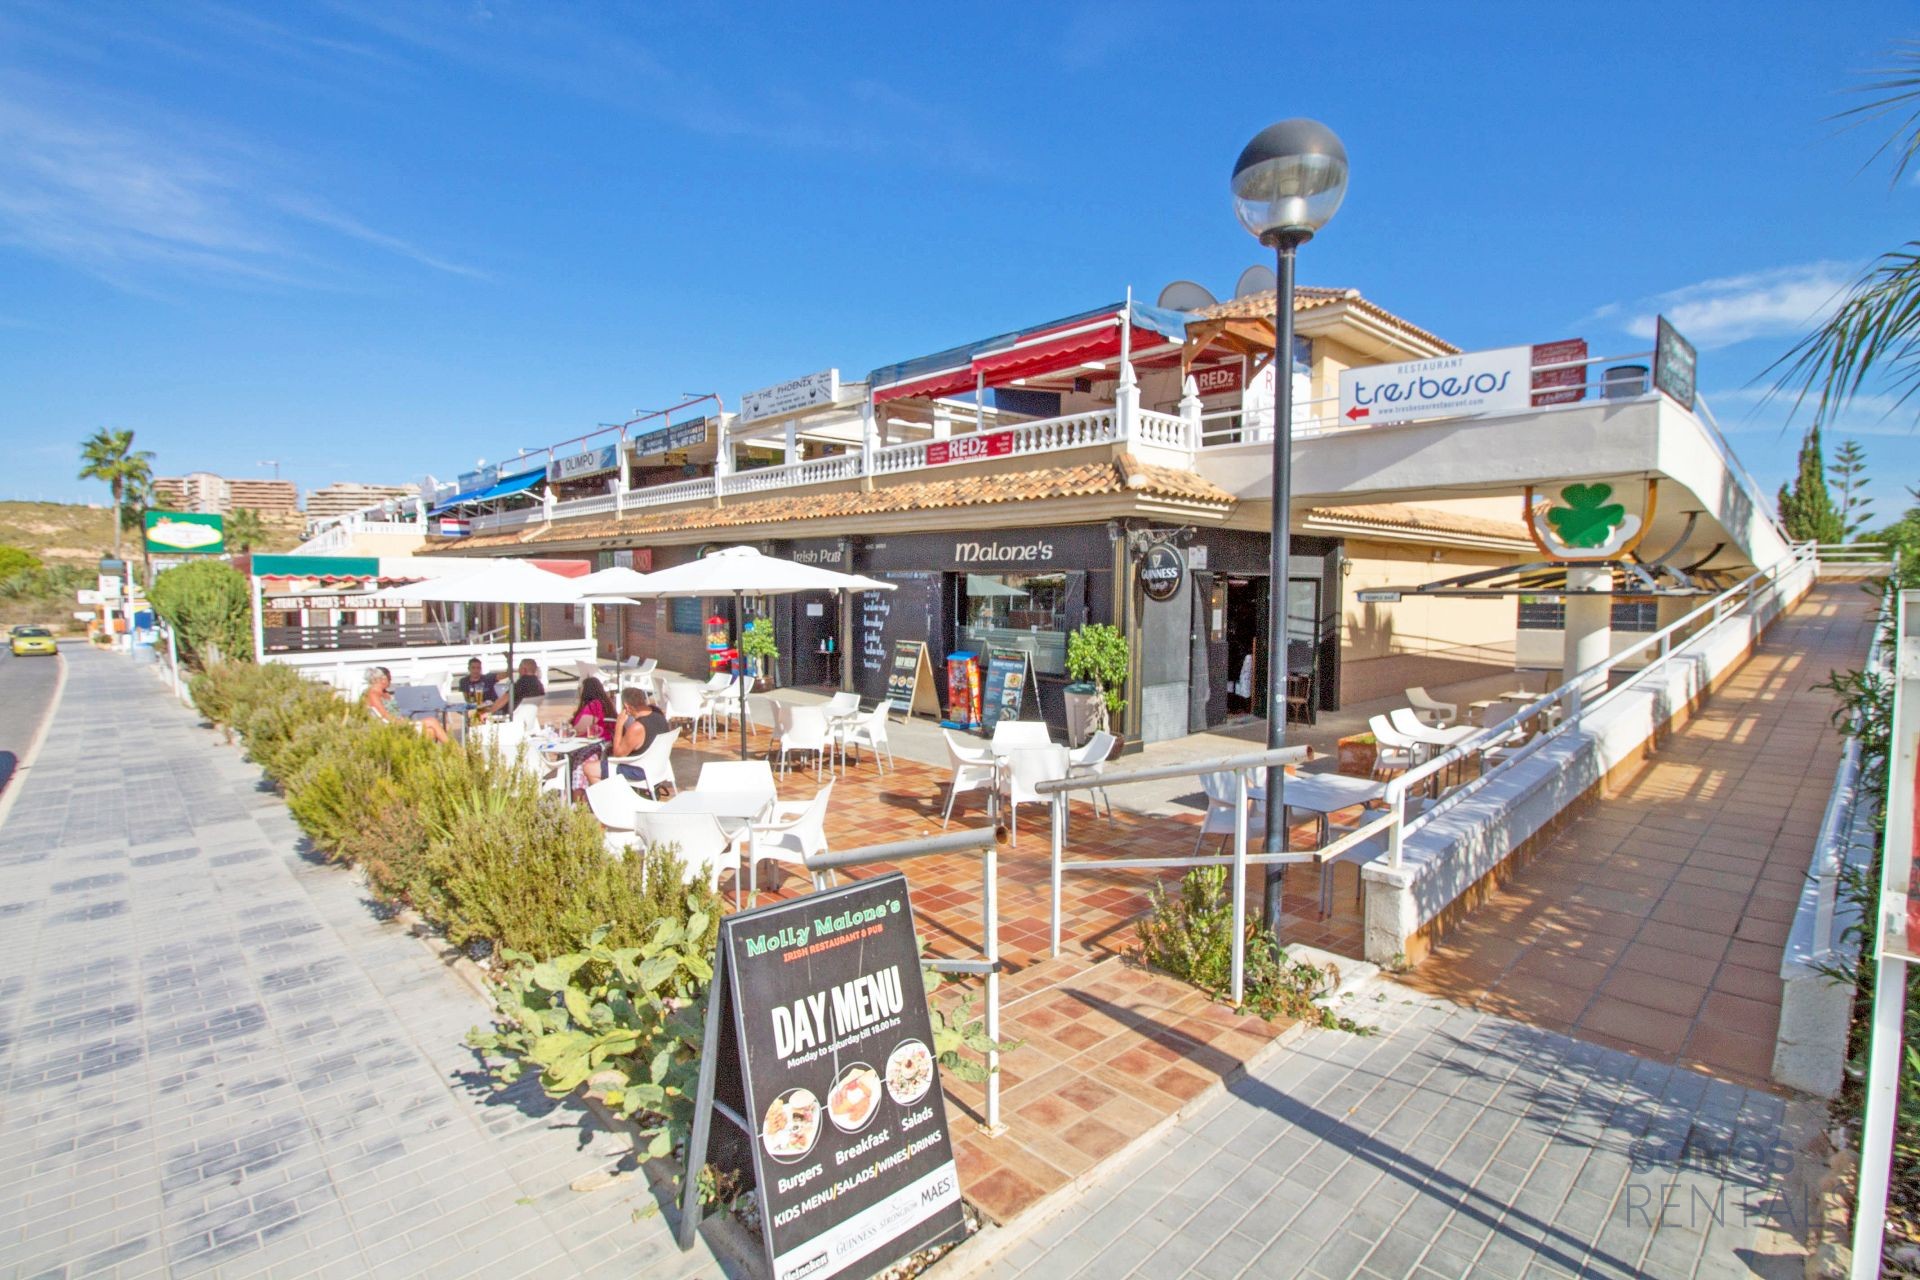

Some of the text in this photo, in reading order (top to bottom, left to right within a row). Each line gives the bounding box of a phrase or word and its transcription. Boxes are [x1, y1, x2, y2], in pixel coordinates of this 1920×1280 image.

[1397, 358, 1463, 375] RESTAURANT
[758, 390, 772, 400] THE
[777, 378, 813, 394] PHOENIX
[1355, 370, 1511, 406] tresbesos
[1378, 398, 1484, 415] www.tresbesosrestaurant.com
[565, 453, 594, 471] OLIMPO
[793, 549, 818, 563] Irish
[955, 540, 1054, 562] Malone's
[1141, 567, 1178, 580] GUINNESS
[745, 899, 901, 958] Molly Malone's
[783, 947, 809, 963] IRISH
[809, 932, 862, 955] RESTAURANT
[868, 923, 884, 936] PUB
[771, 965, 904, 1060] DAY MENU
[787, 1049, 818, 1069] Monday
[818, 1046, 827, 1057] to
[860, 1026, 871, 1040] till
[901, 1106, 934, 1132] Salads
[835, 1128, 891, 1166] Breakfast
[777, 1163, 824, 1194] Burgers
[920, 1177, 951, 1208] MAES
[774, 1205, 801, 1228] KIDS
